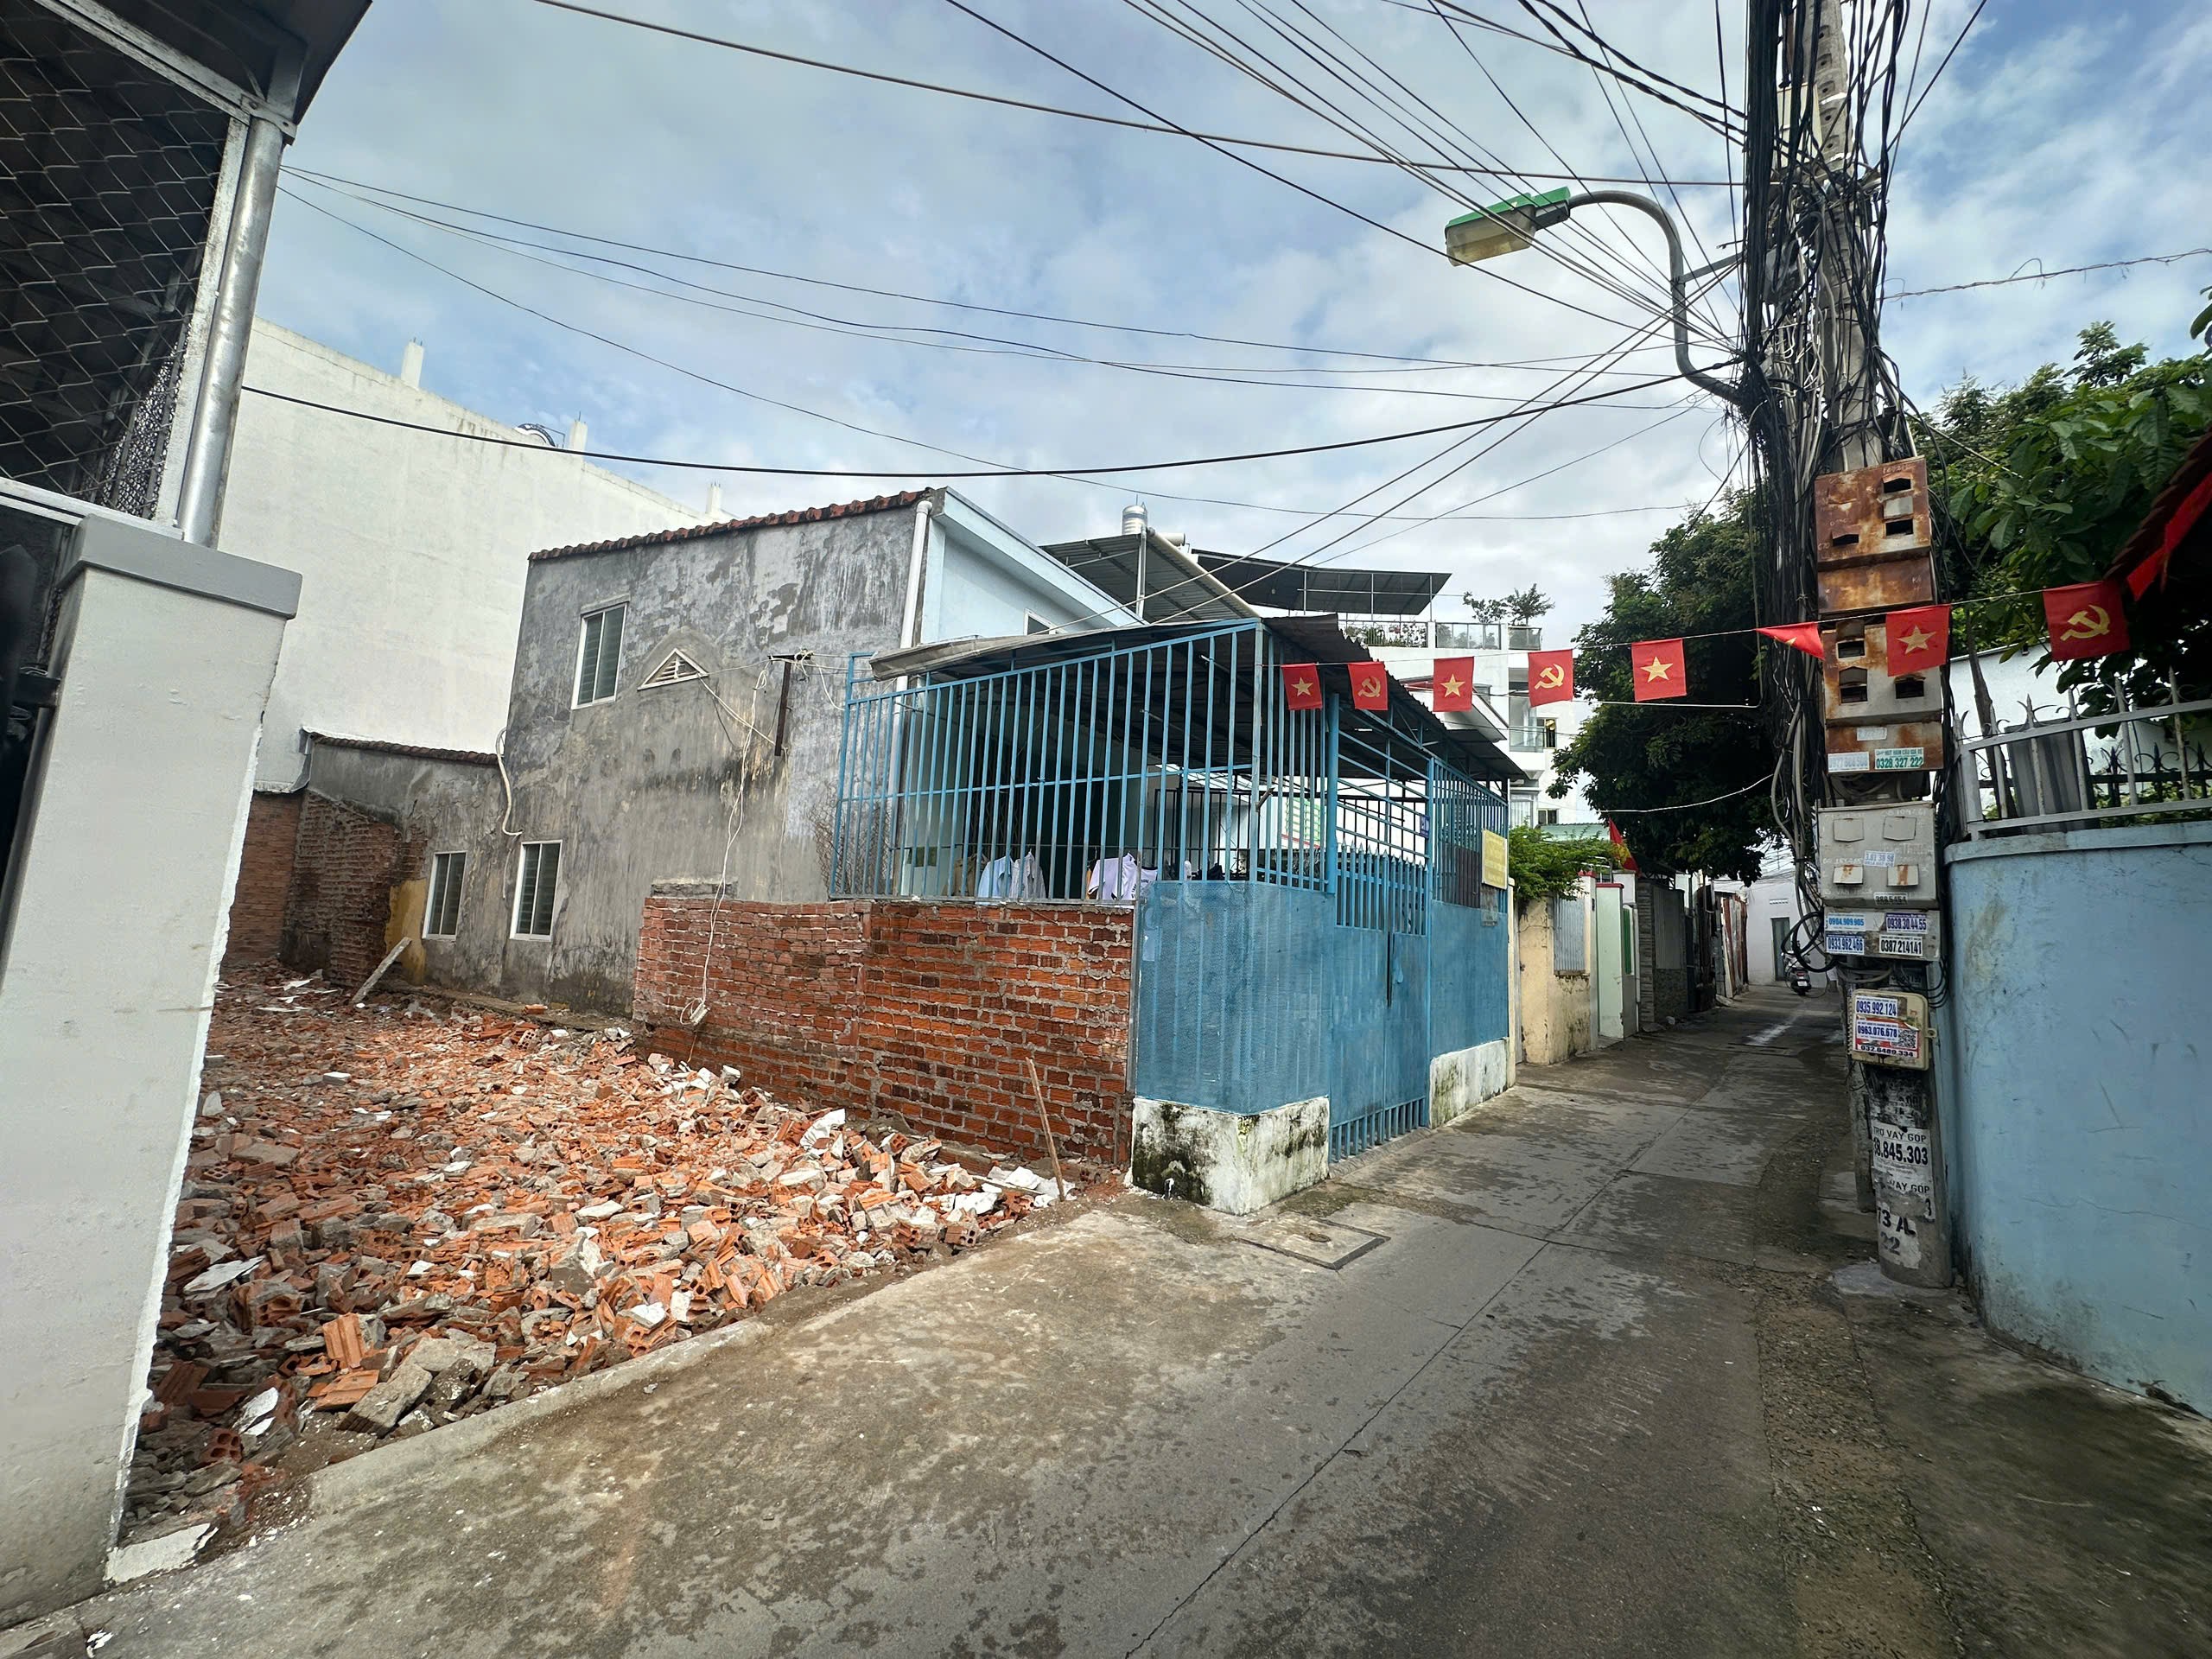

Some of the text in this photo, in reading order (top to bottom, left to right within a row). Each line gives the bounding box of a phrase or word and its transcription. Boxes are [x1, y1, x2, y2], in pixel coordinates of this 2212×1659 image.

[1856, 1001, 1897, 1016] 0935.992.124
[1857, 1025, 1897, 1038] 0963.076.678
[1886, 1129, 1904, 1140] VAY
